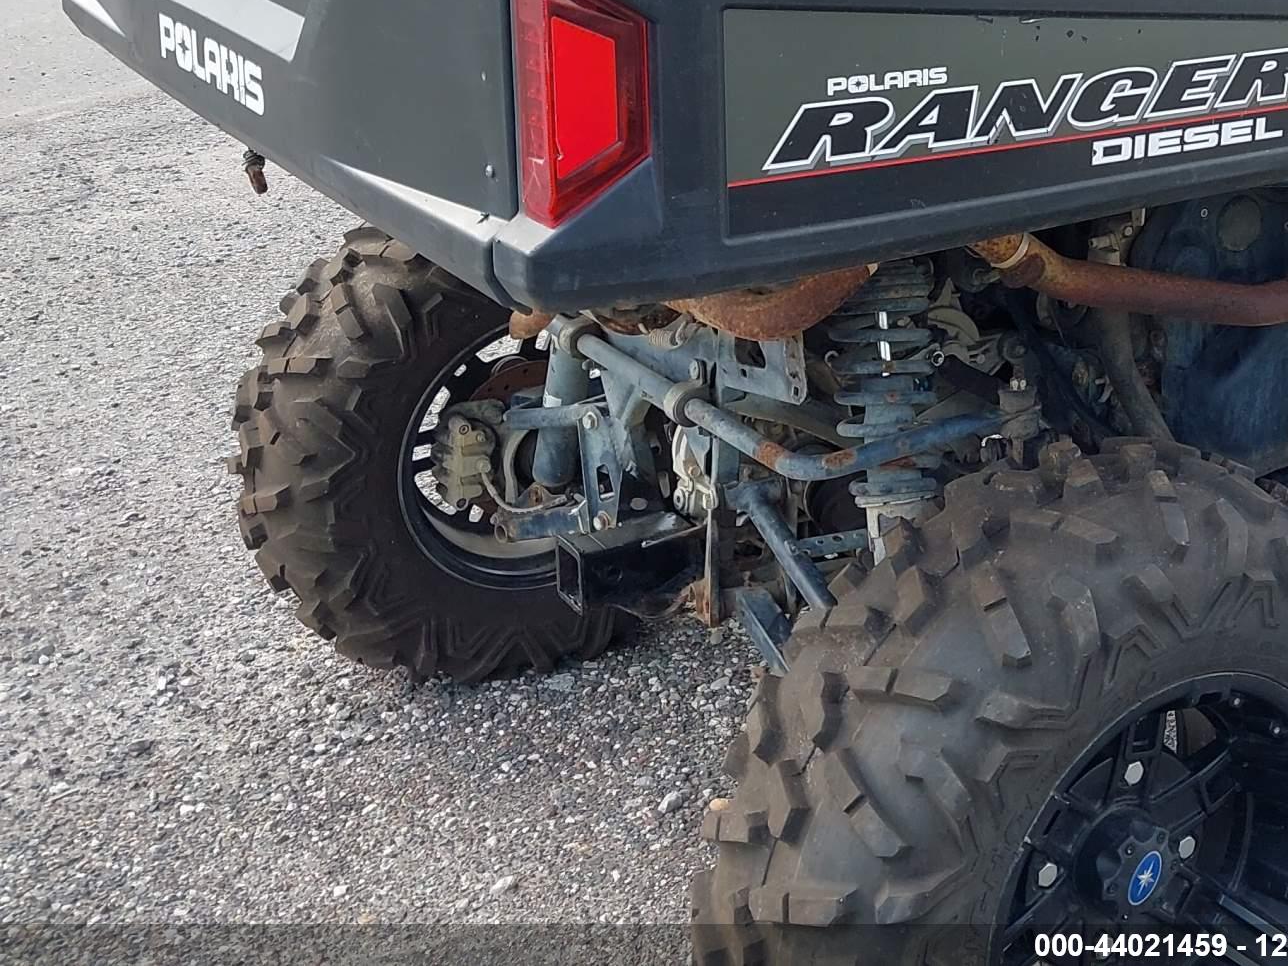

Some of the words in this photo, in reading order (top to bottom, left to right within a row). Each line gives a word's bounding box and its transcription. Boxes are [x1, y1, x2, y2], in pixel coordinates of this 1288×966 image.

[158, 12, 265, 116] POLARIS
[827, 66, 949, 96] POLARIS
[1091, 117, 1283, 167] DIESEL
